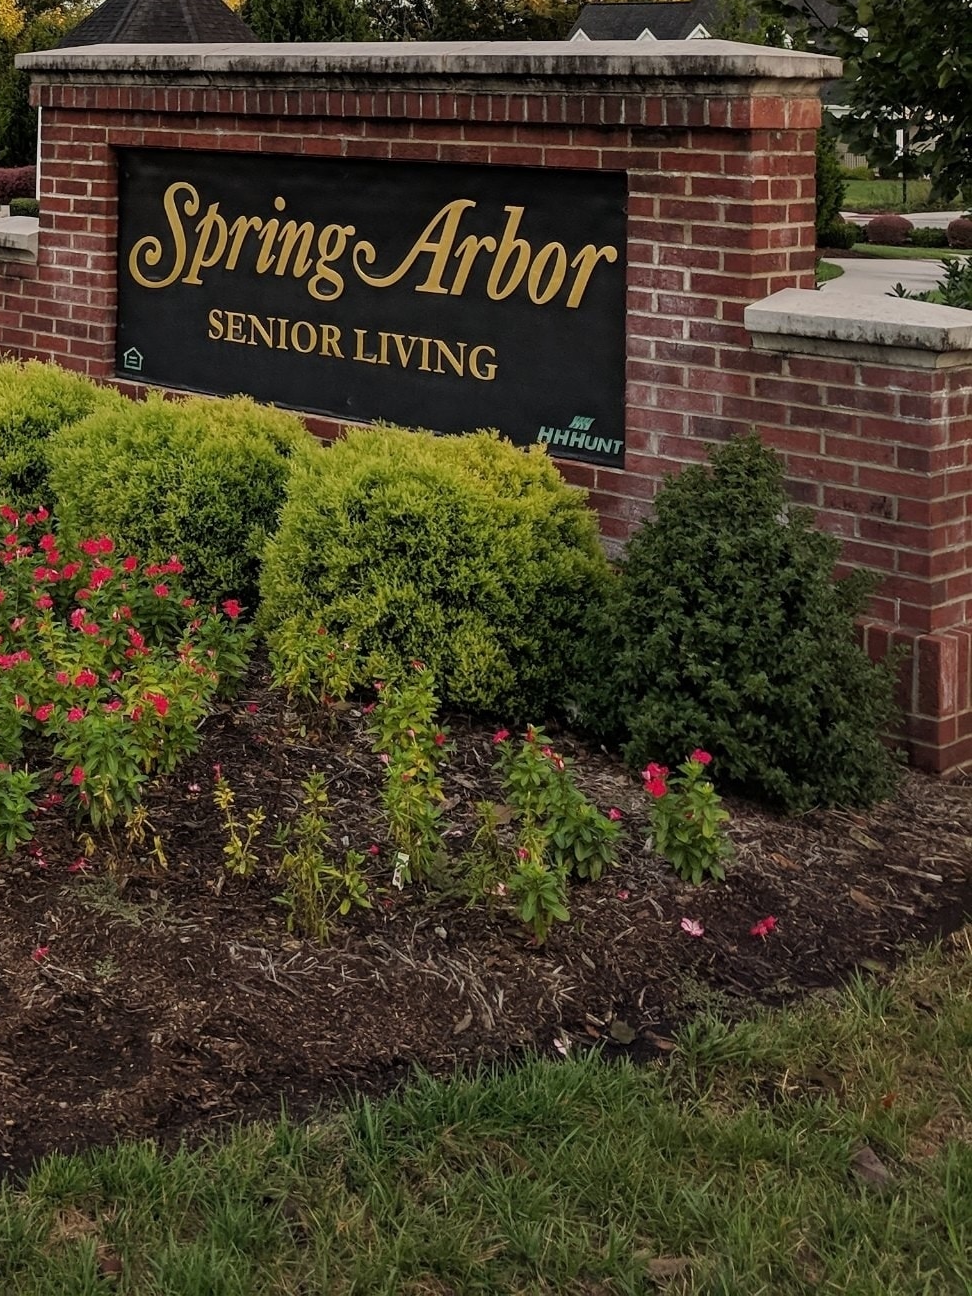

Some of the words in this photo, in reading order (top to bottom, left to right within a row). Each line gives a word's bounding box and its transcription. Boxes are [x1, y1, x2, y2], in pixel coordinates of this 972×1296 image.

[129, 181, 356, 301] Spring
[352, 199, 618, 308] Arbor
[208, 308, 343, 358] SENIOR
[353, 328, 499, 381] LIVING
[537, 426, 623, 454] HHHUNT
